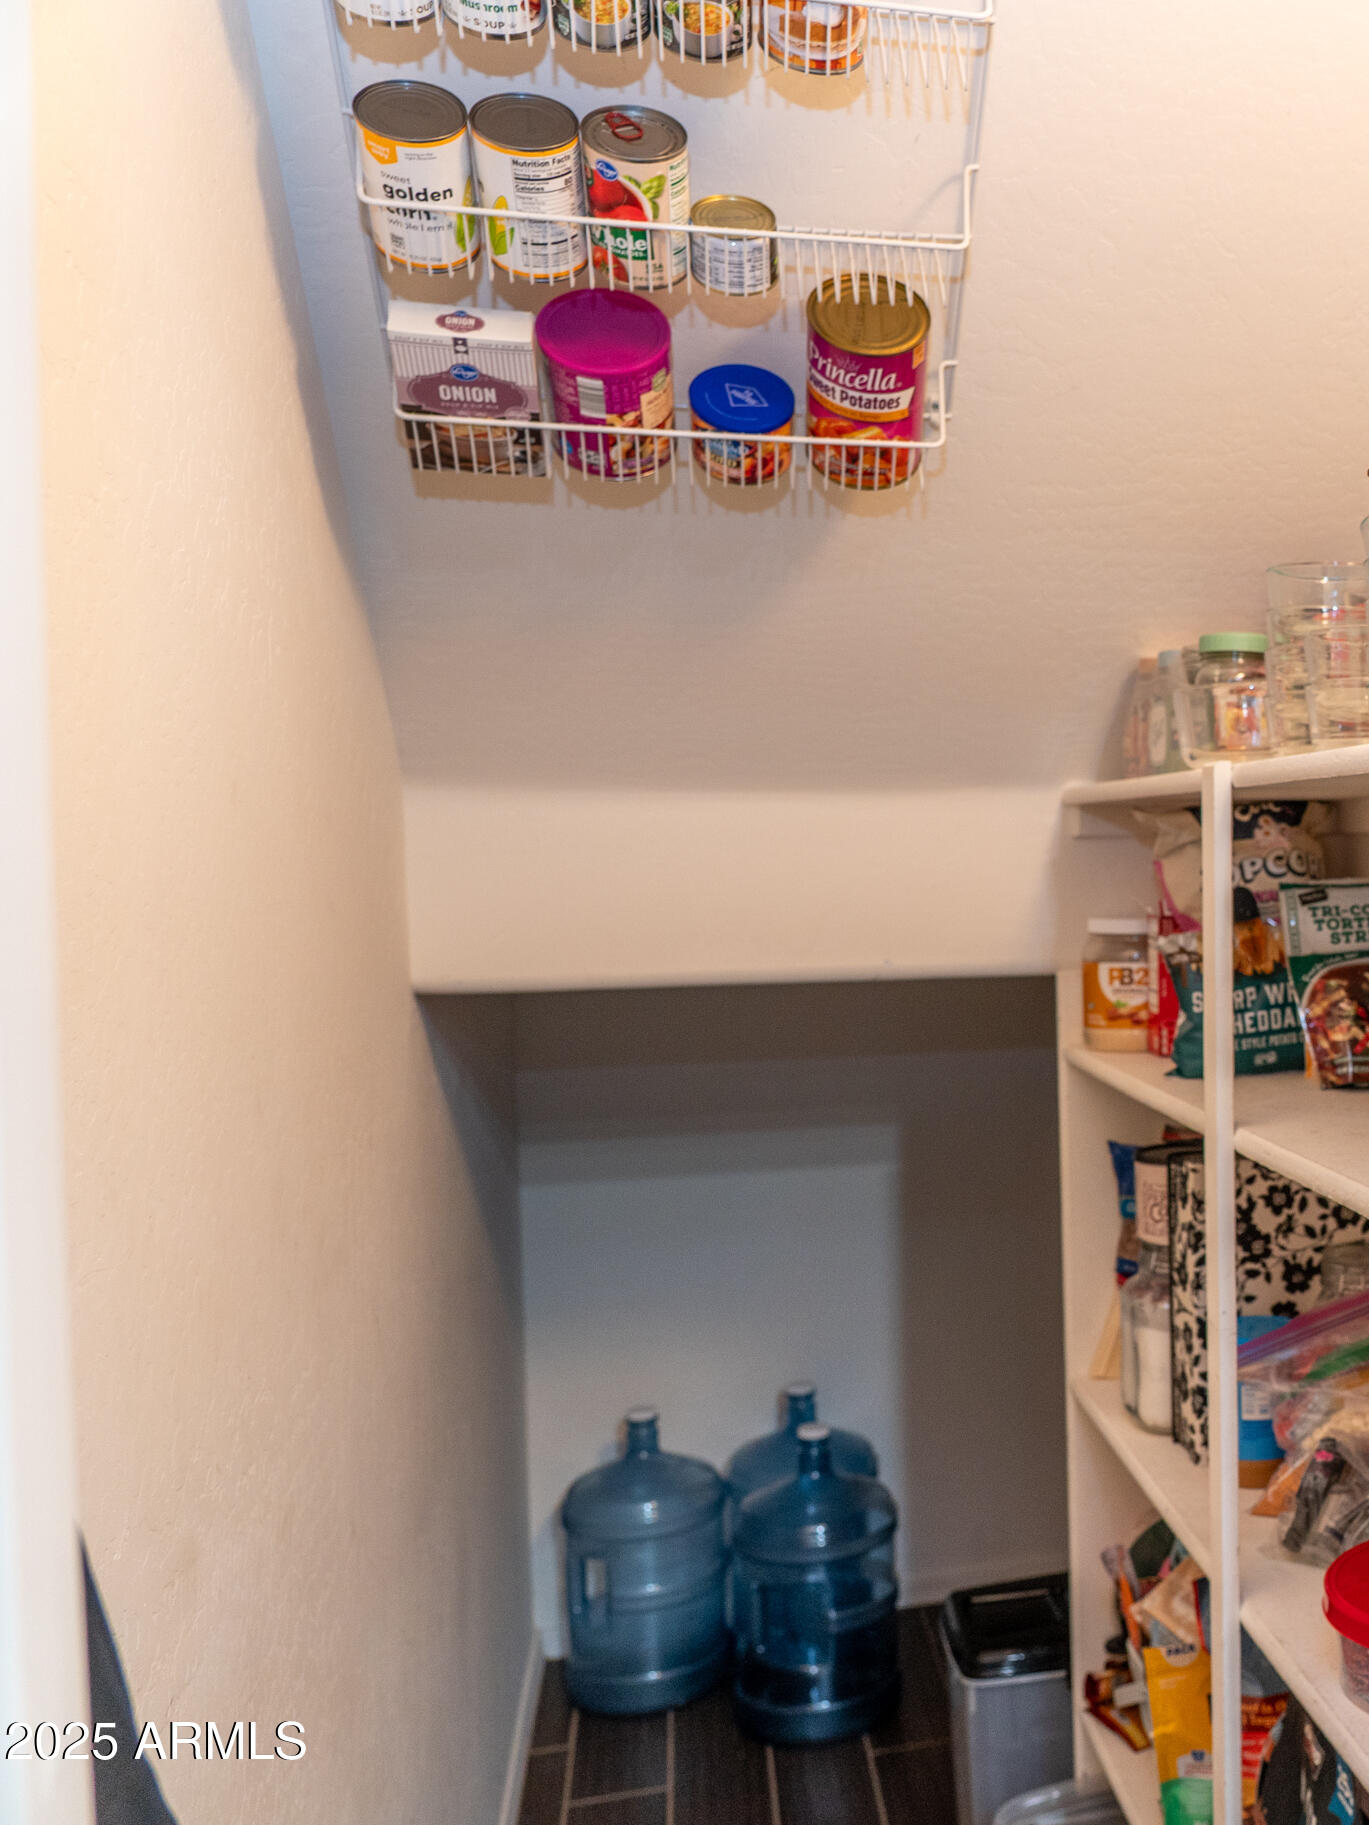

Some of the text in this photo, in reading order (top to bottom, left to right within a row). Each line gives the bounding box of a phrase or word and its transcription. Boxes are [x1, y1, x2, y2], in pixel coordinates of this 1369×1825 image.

[512, 154, 571, 168] Nutrition Facts
[380, 170, 411, 184] sweet
[383, 183, 453, 202] golden
[445, 317, 476, 326] ONION
[809, 341, 897, 391] Princella
[438, 385, 497, 403] ONION
[840, 391, 901, 410] Potatoes
[1233, 1007, 1300, 1035] HEDDA
